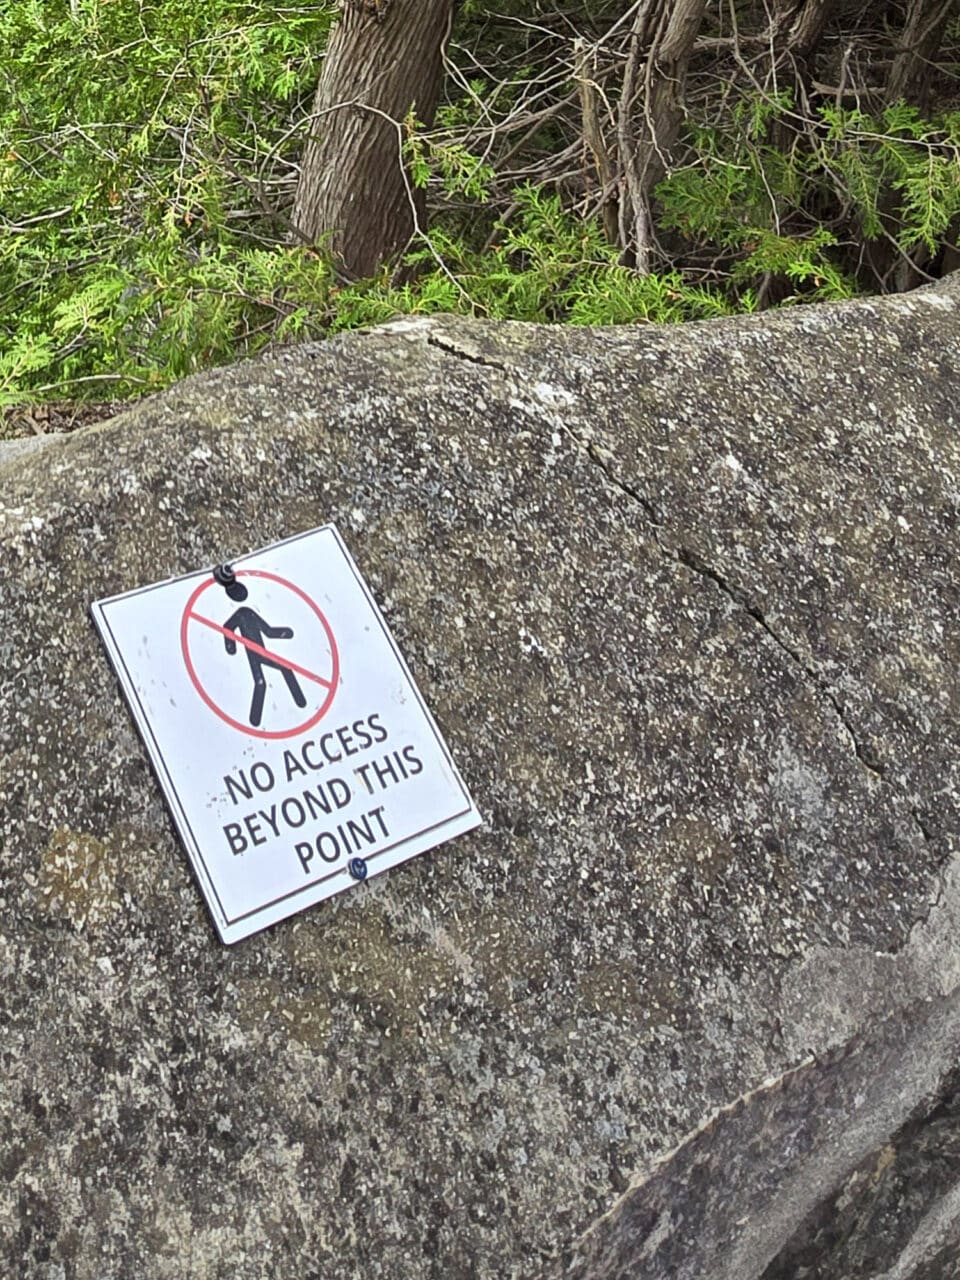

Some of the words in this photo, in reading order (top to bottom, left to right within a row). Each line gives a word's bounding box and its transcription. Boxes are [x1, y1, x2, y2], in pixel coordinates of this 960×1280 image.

[222, 778, 352, 856] BEYOND
[353, 745, 423, 795] THIS
[223, 762, 275, 805] NO
[283, 714, 388, 782] ACCESS
[294, 806, 390, 874] POINT
